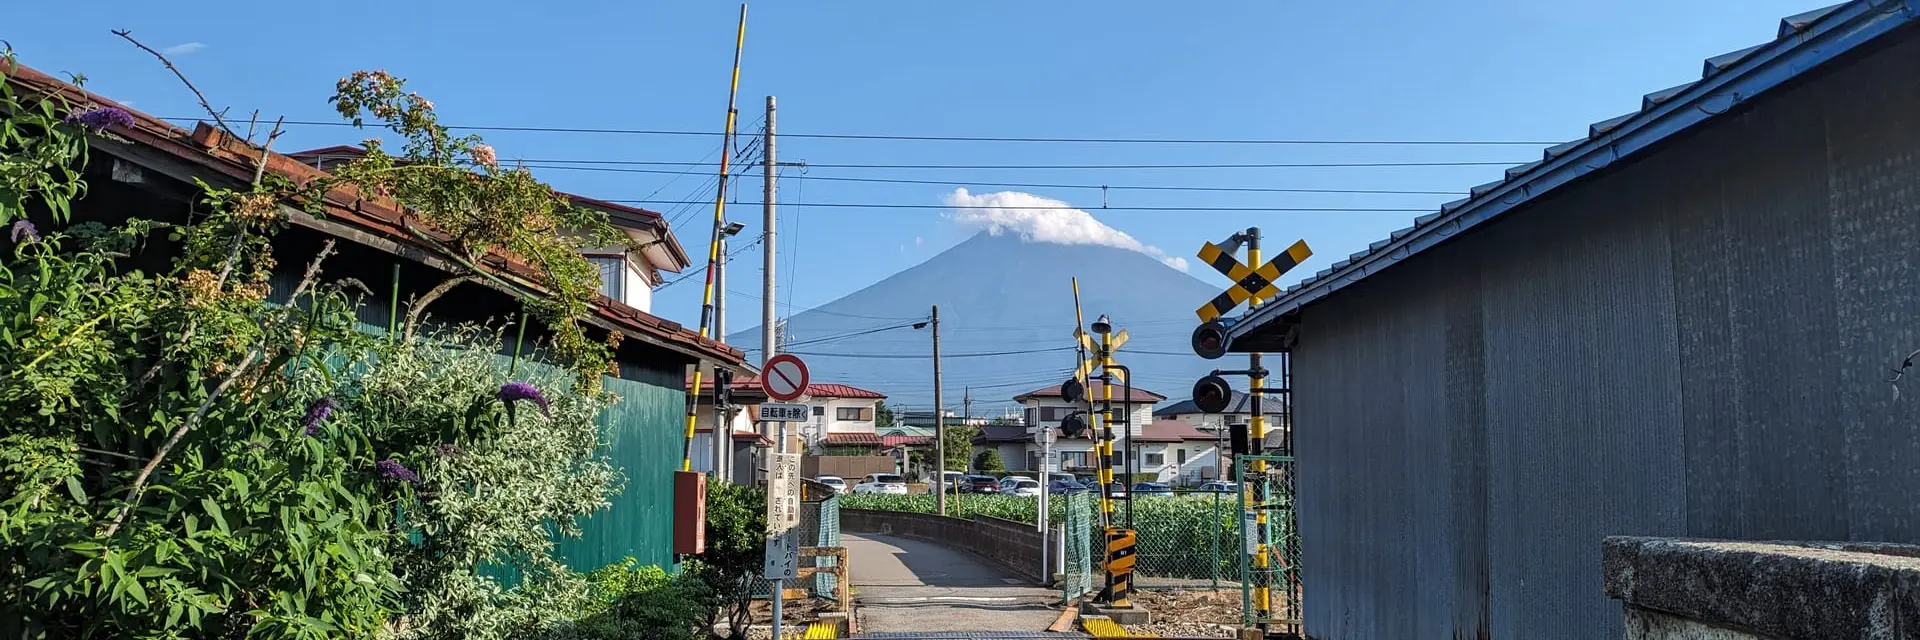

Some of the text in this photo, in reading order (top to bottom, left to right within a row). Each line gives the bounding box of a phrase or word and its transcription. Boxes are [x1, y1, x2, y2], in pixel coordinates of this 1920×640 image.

[761, 407, 806, 419] 自転車を除く
